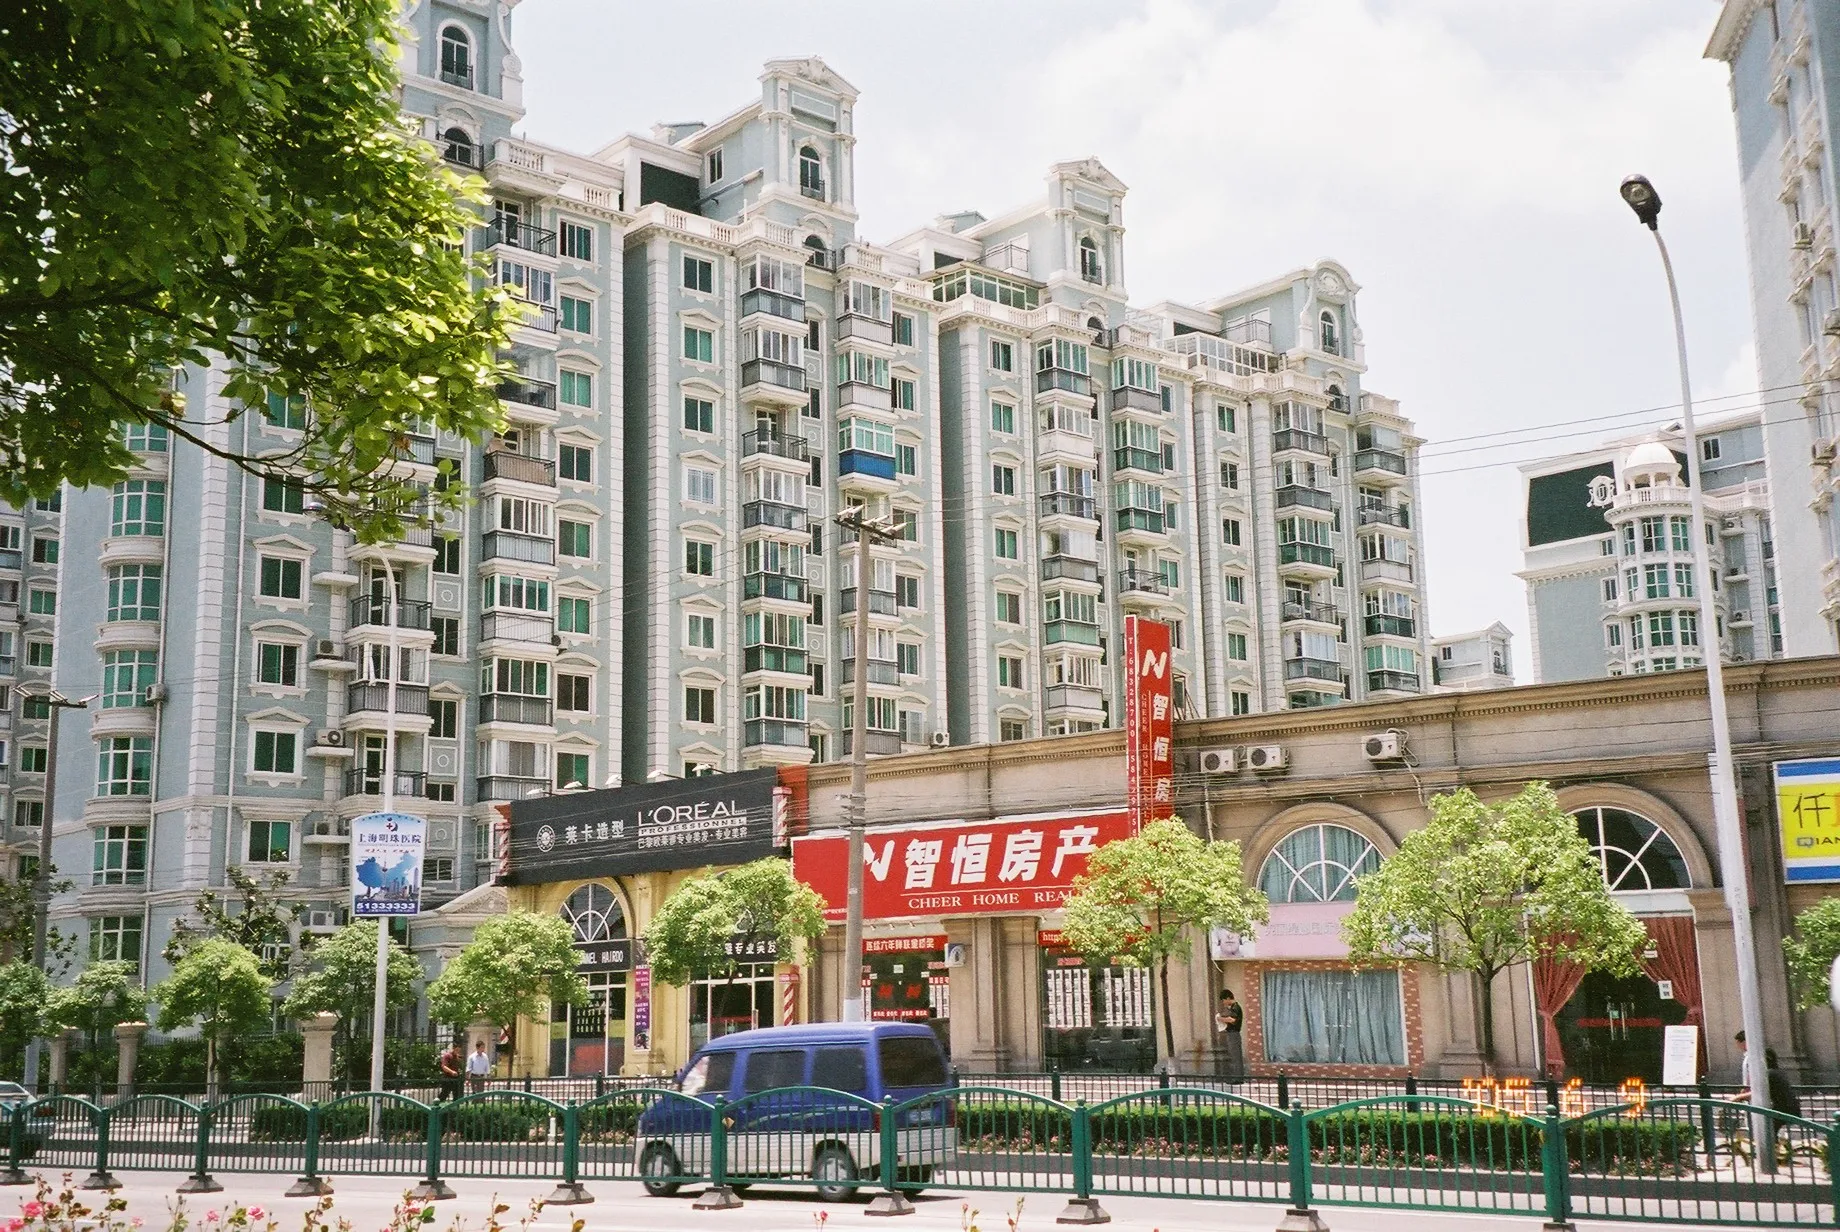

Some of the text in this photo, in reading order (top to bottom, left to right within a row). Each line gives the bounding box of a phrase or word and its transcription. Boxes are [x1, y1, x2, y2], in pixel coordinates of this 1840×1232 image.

[640, 818, 746, 836] PROFESSIONNEL
[905, 825, 1099, 889] 智恒房产
[908, 895, 961, 909] CHEER
[973, 892, 1019, 905] HOME
